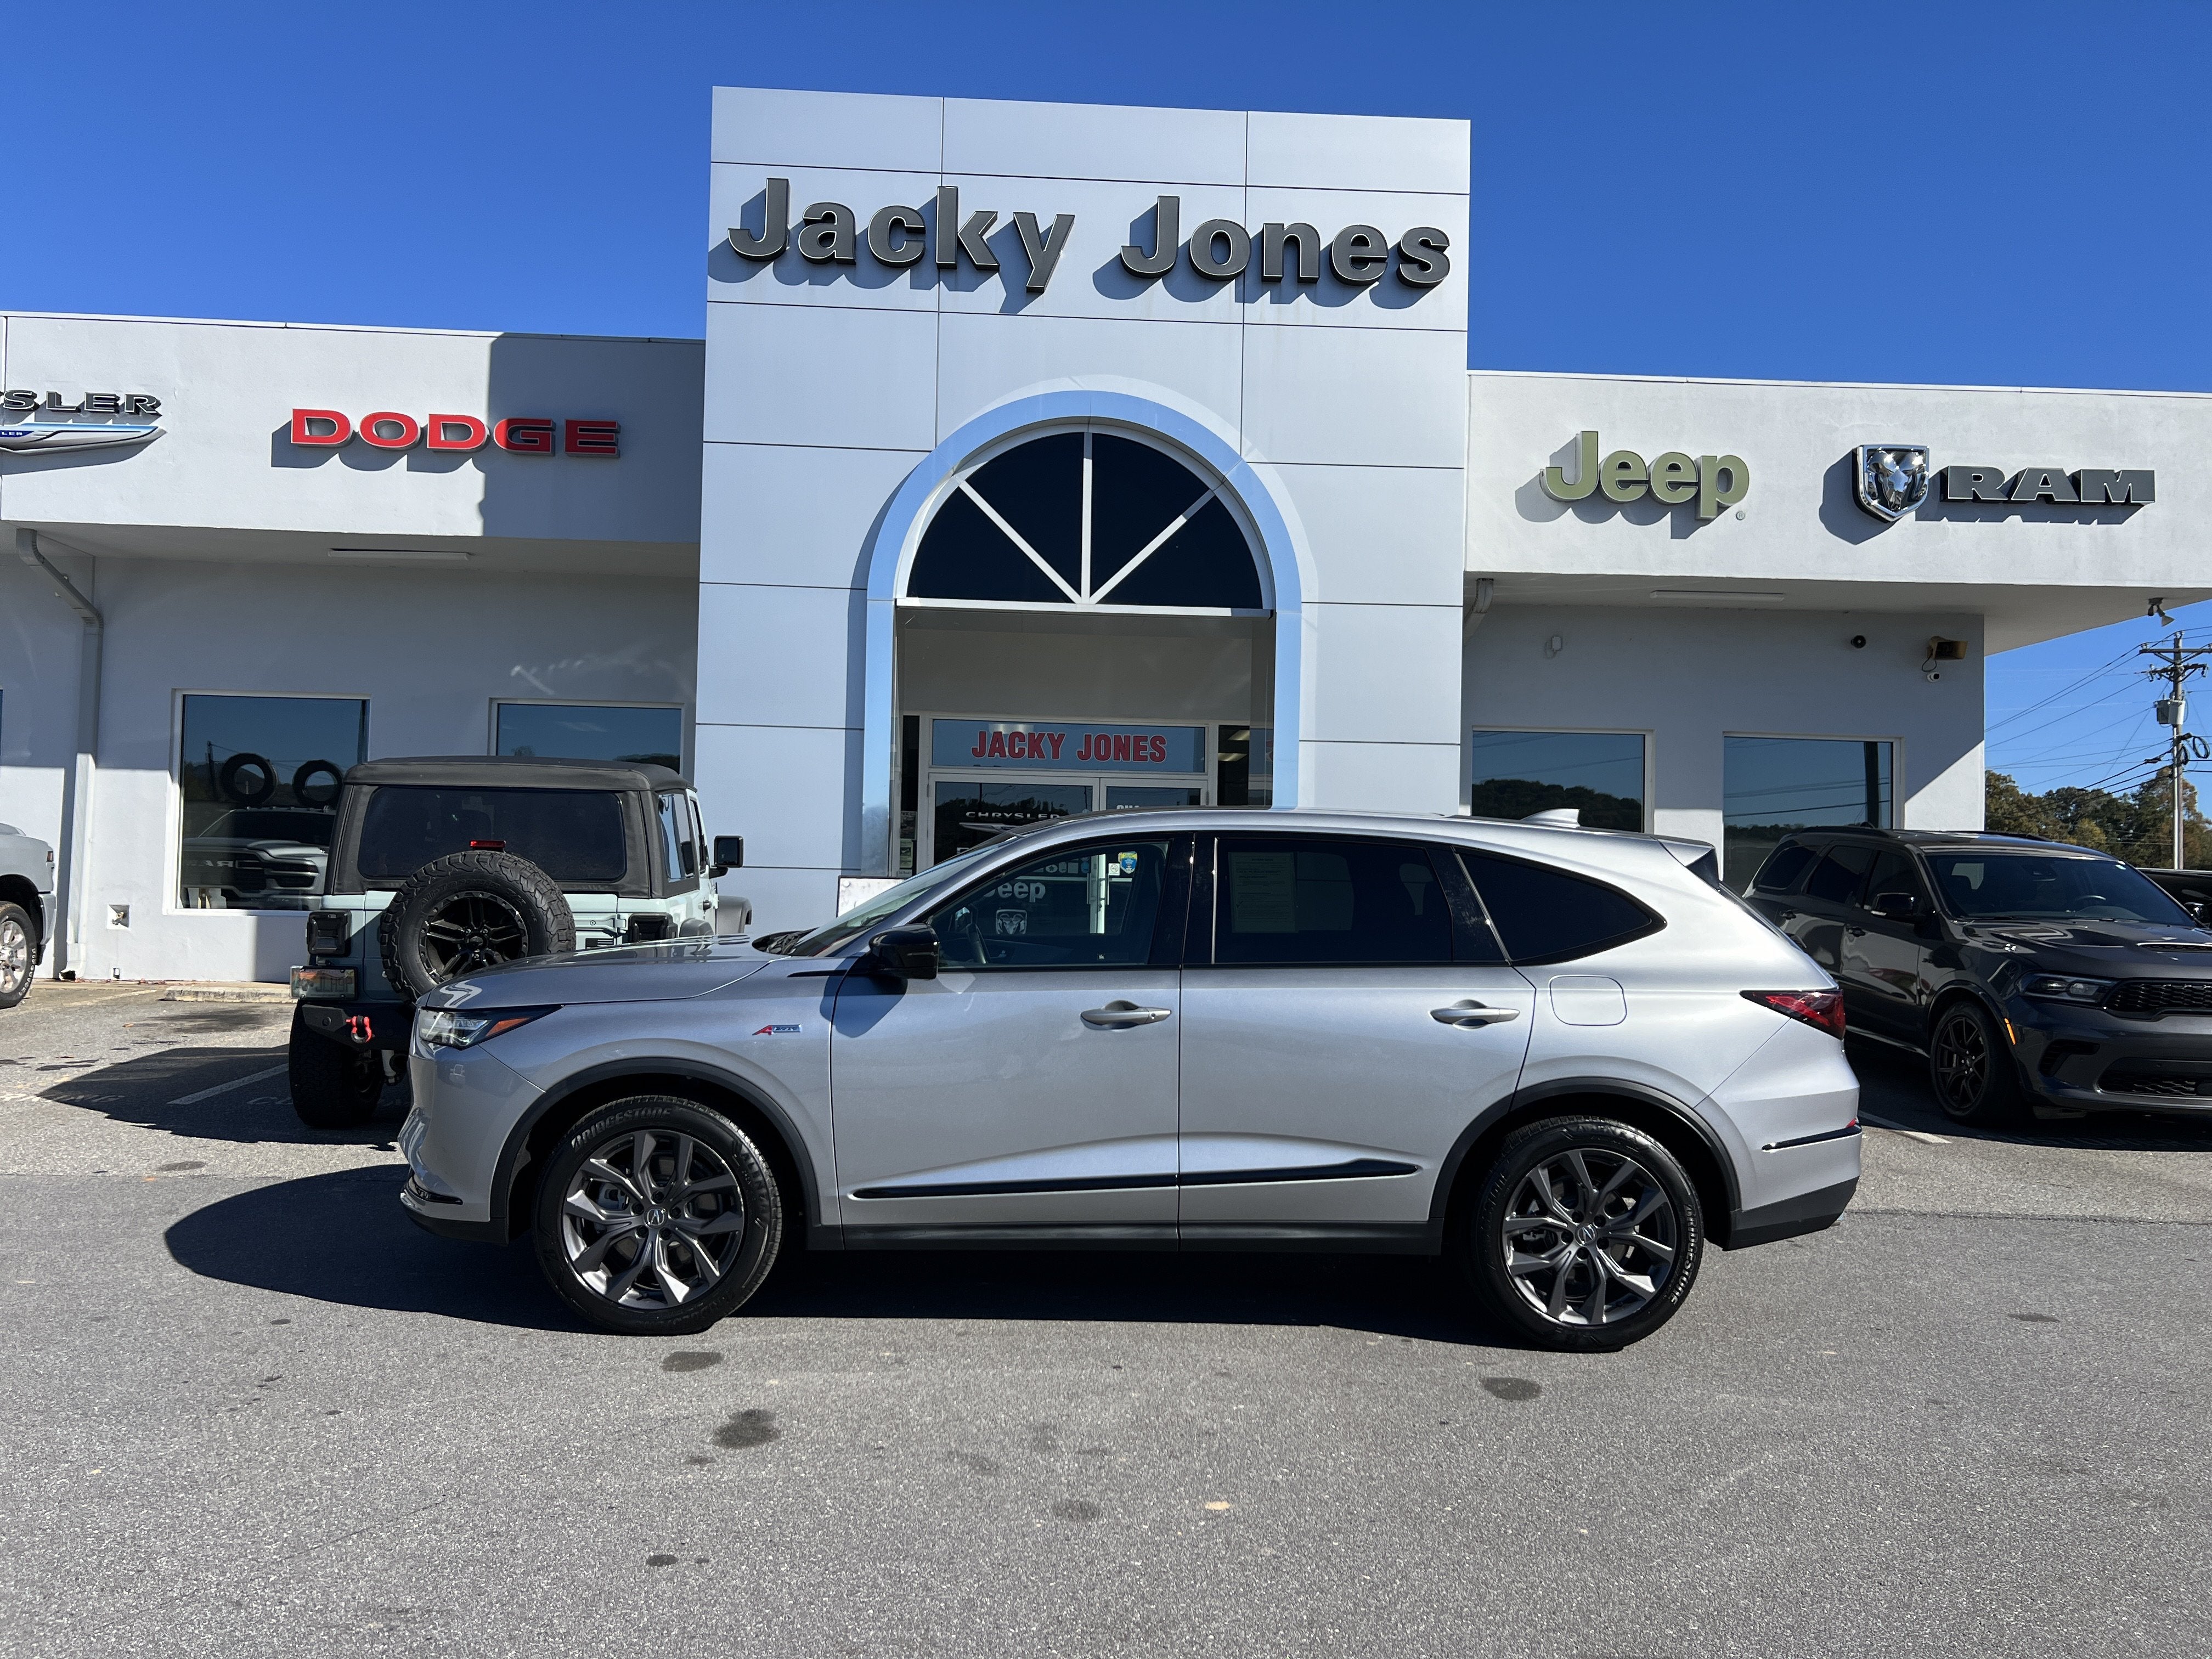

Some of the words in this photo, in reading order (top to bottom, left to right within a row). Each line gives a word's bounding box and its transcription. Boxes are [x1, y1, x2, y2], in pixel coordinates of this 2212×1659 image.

[727, 177, 1075, 293] Jacky
[1120, 195, 1451, 288] Jones
[0, 390, 161, 414] SLER
[291, 408, 620, 458] DODGE
[1541, 431, 1750, 520] Jeep
[1941, 465, 2155, 503] RAM
[972, 730, 1066, 760] JACKY
[1077, 733, 1167, 763] JONES
[984, 882, 1046, 903] eep
[571, 1107, 674, 1149] BRIDGESTONE
[1670, 1204, 1699, 1305] BRIDGESTONE
